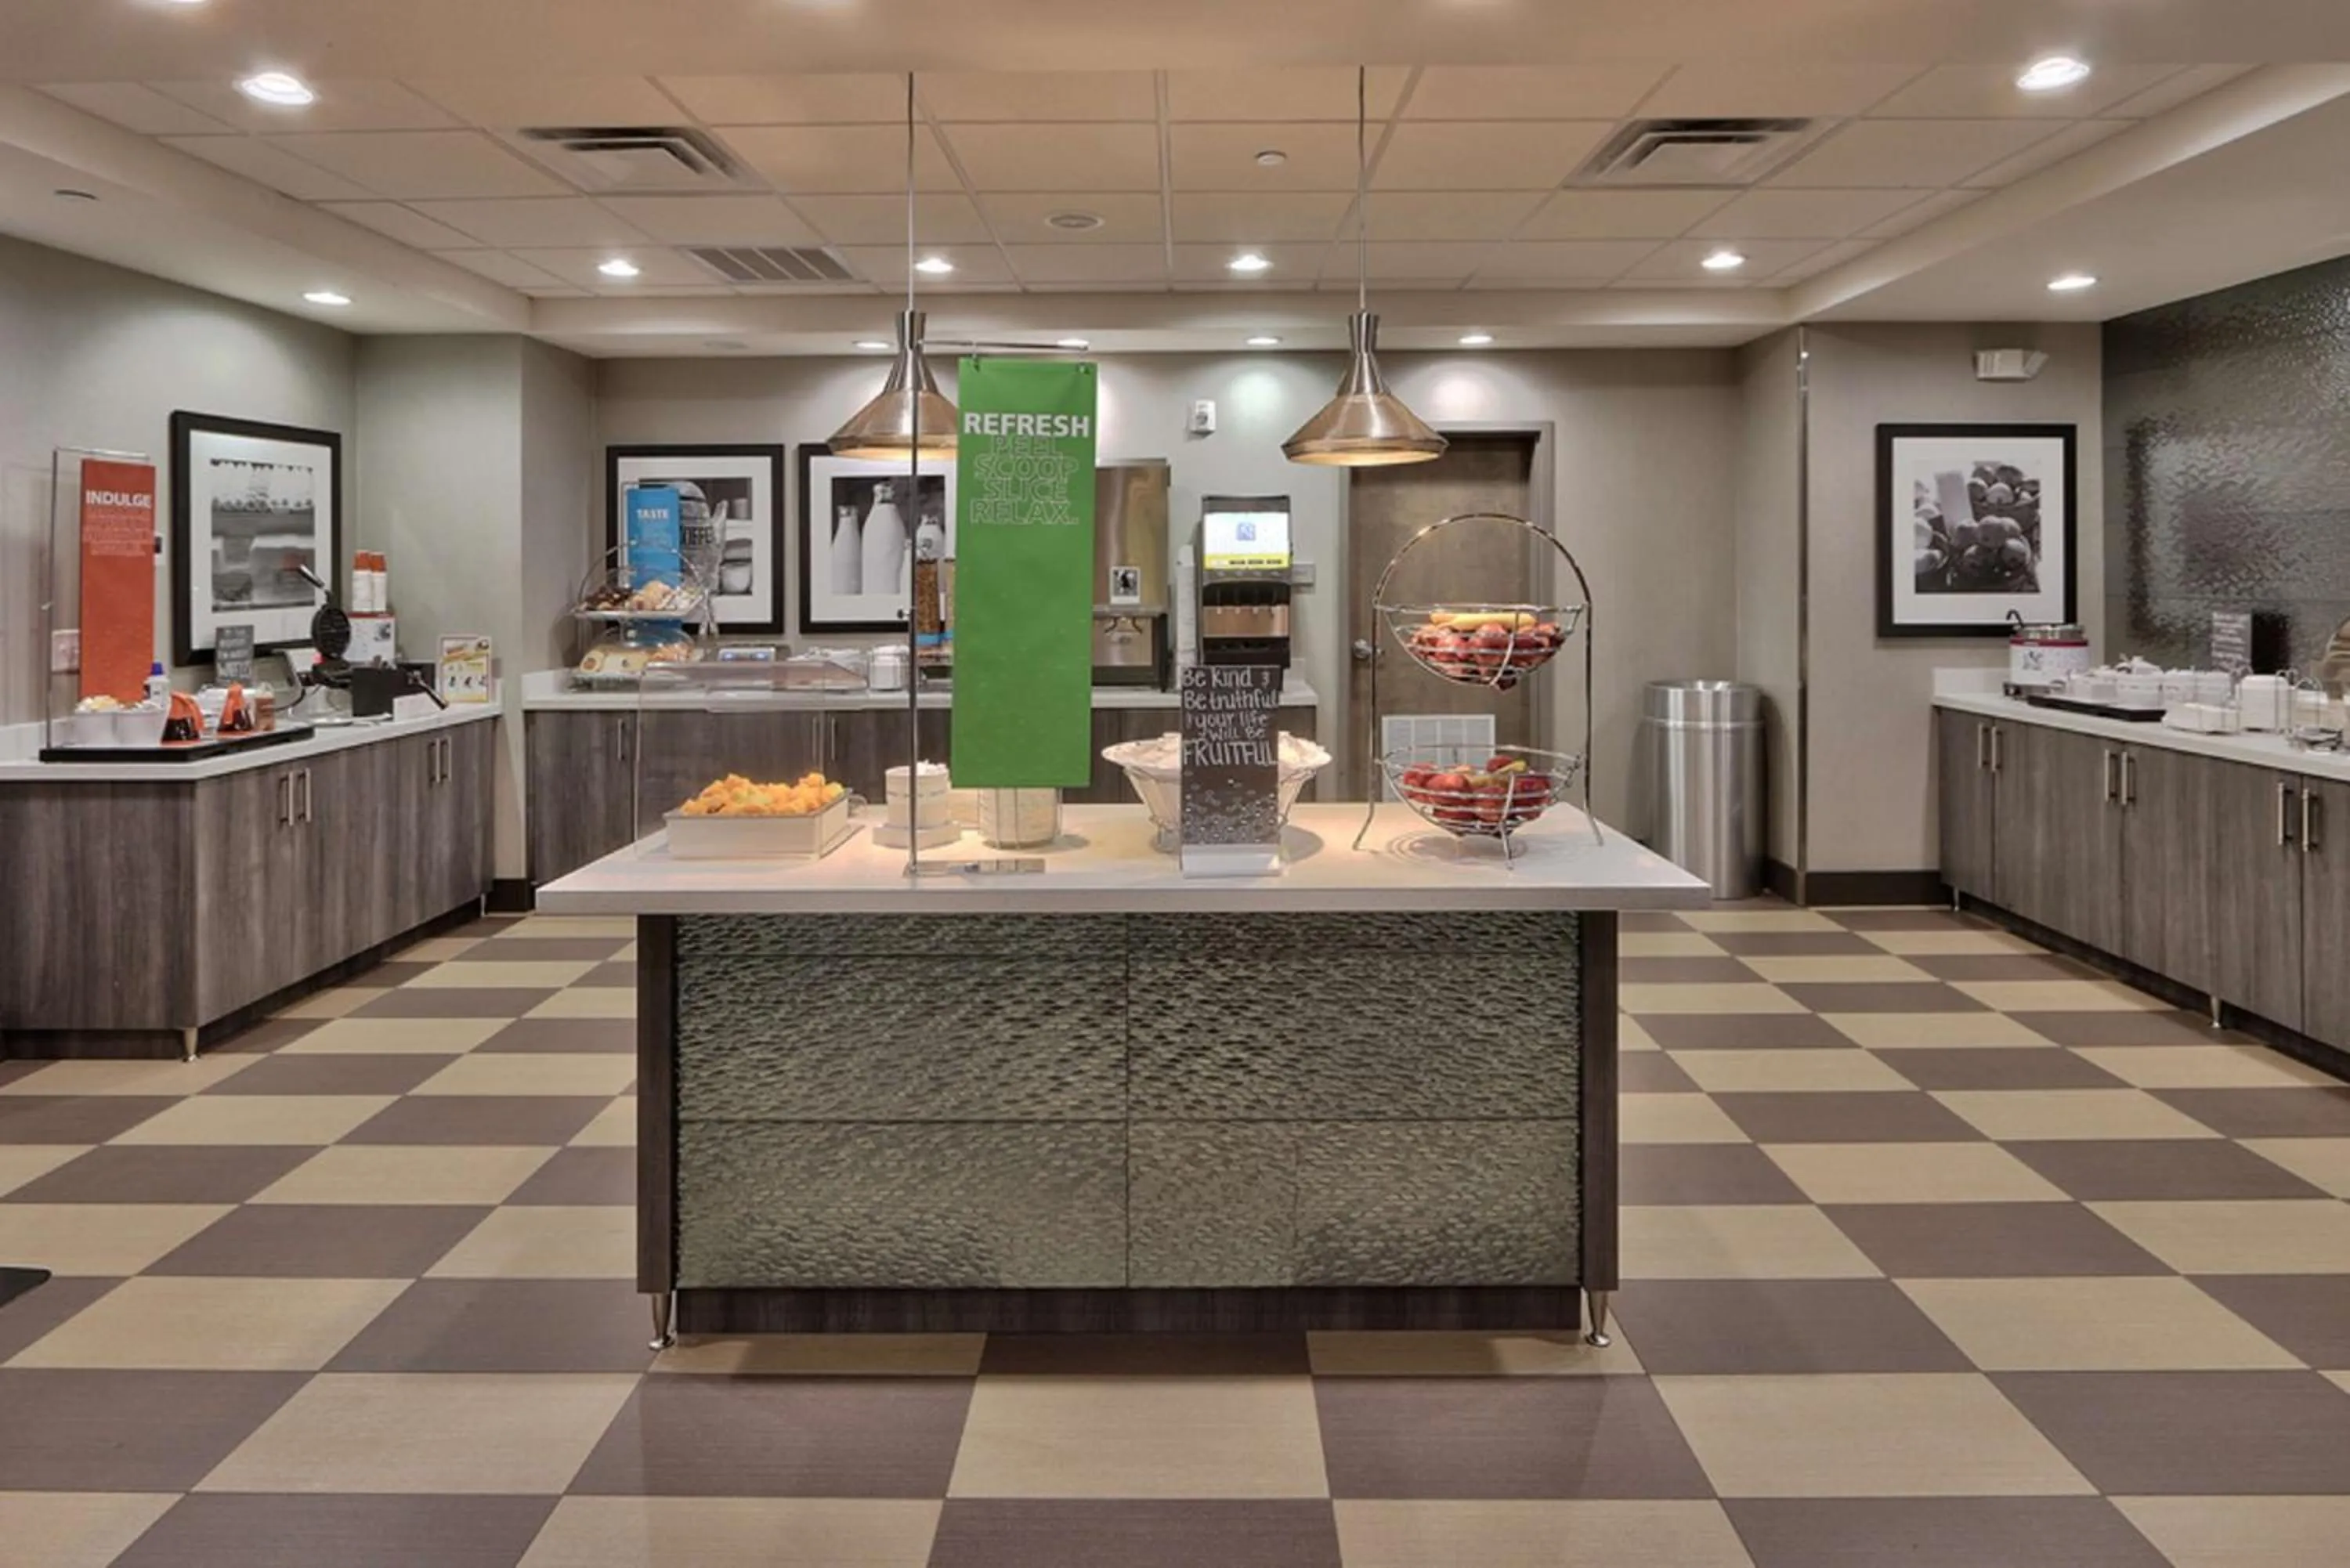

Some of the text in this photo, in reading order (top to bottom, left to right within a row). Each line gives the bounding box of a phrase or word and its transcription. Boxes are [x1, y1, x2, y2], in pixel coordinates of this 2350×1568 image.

[964, 412, 1090, 438] REFRESH
[992, 435, 1062, 456] PEEL
[974, 452, 1079, 482] SCOOP
[85, 489, 152, 509] INDULGE
[983, 477, 1068, 502] SLICE
[636, 508, 669, 520] TASTE
[1182, 669, 1207, 688] Be
[1184, 688, 1278, 710] Be truthful
[1195, 714, 1235, 738] your
[1238, 710, 1269, 728] life
[1183, 738, 1278, 767] FRUITFUL
